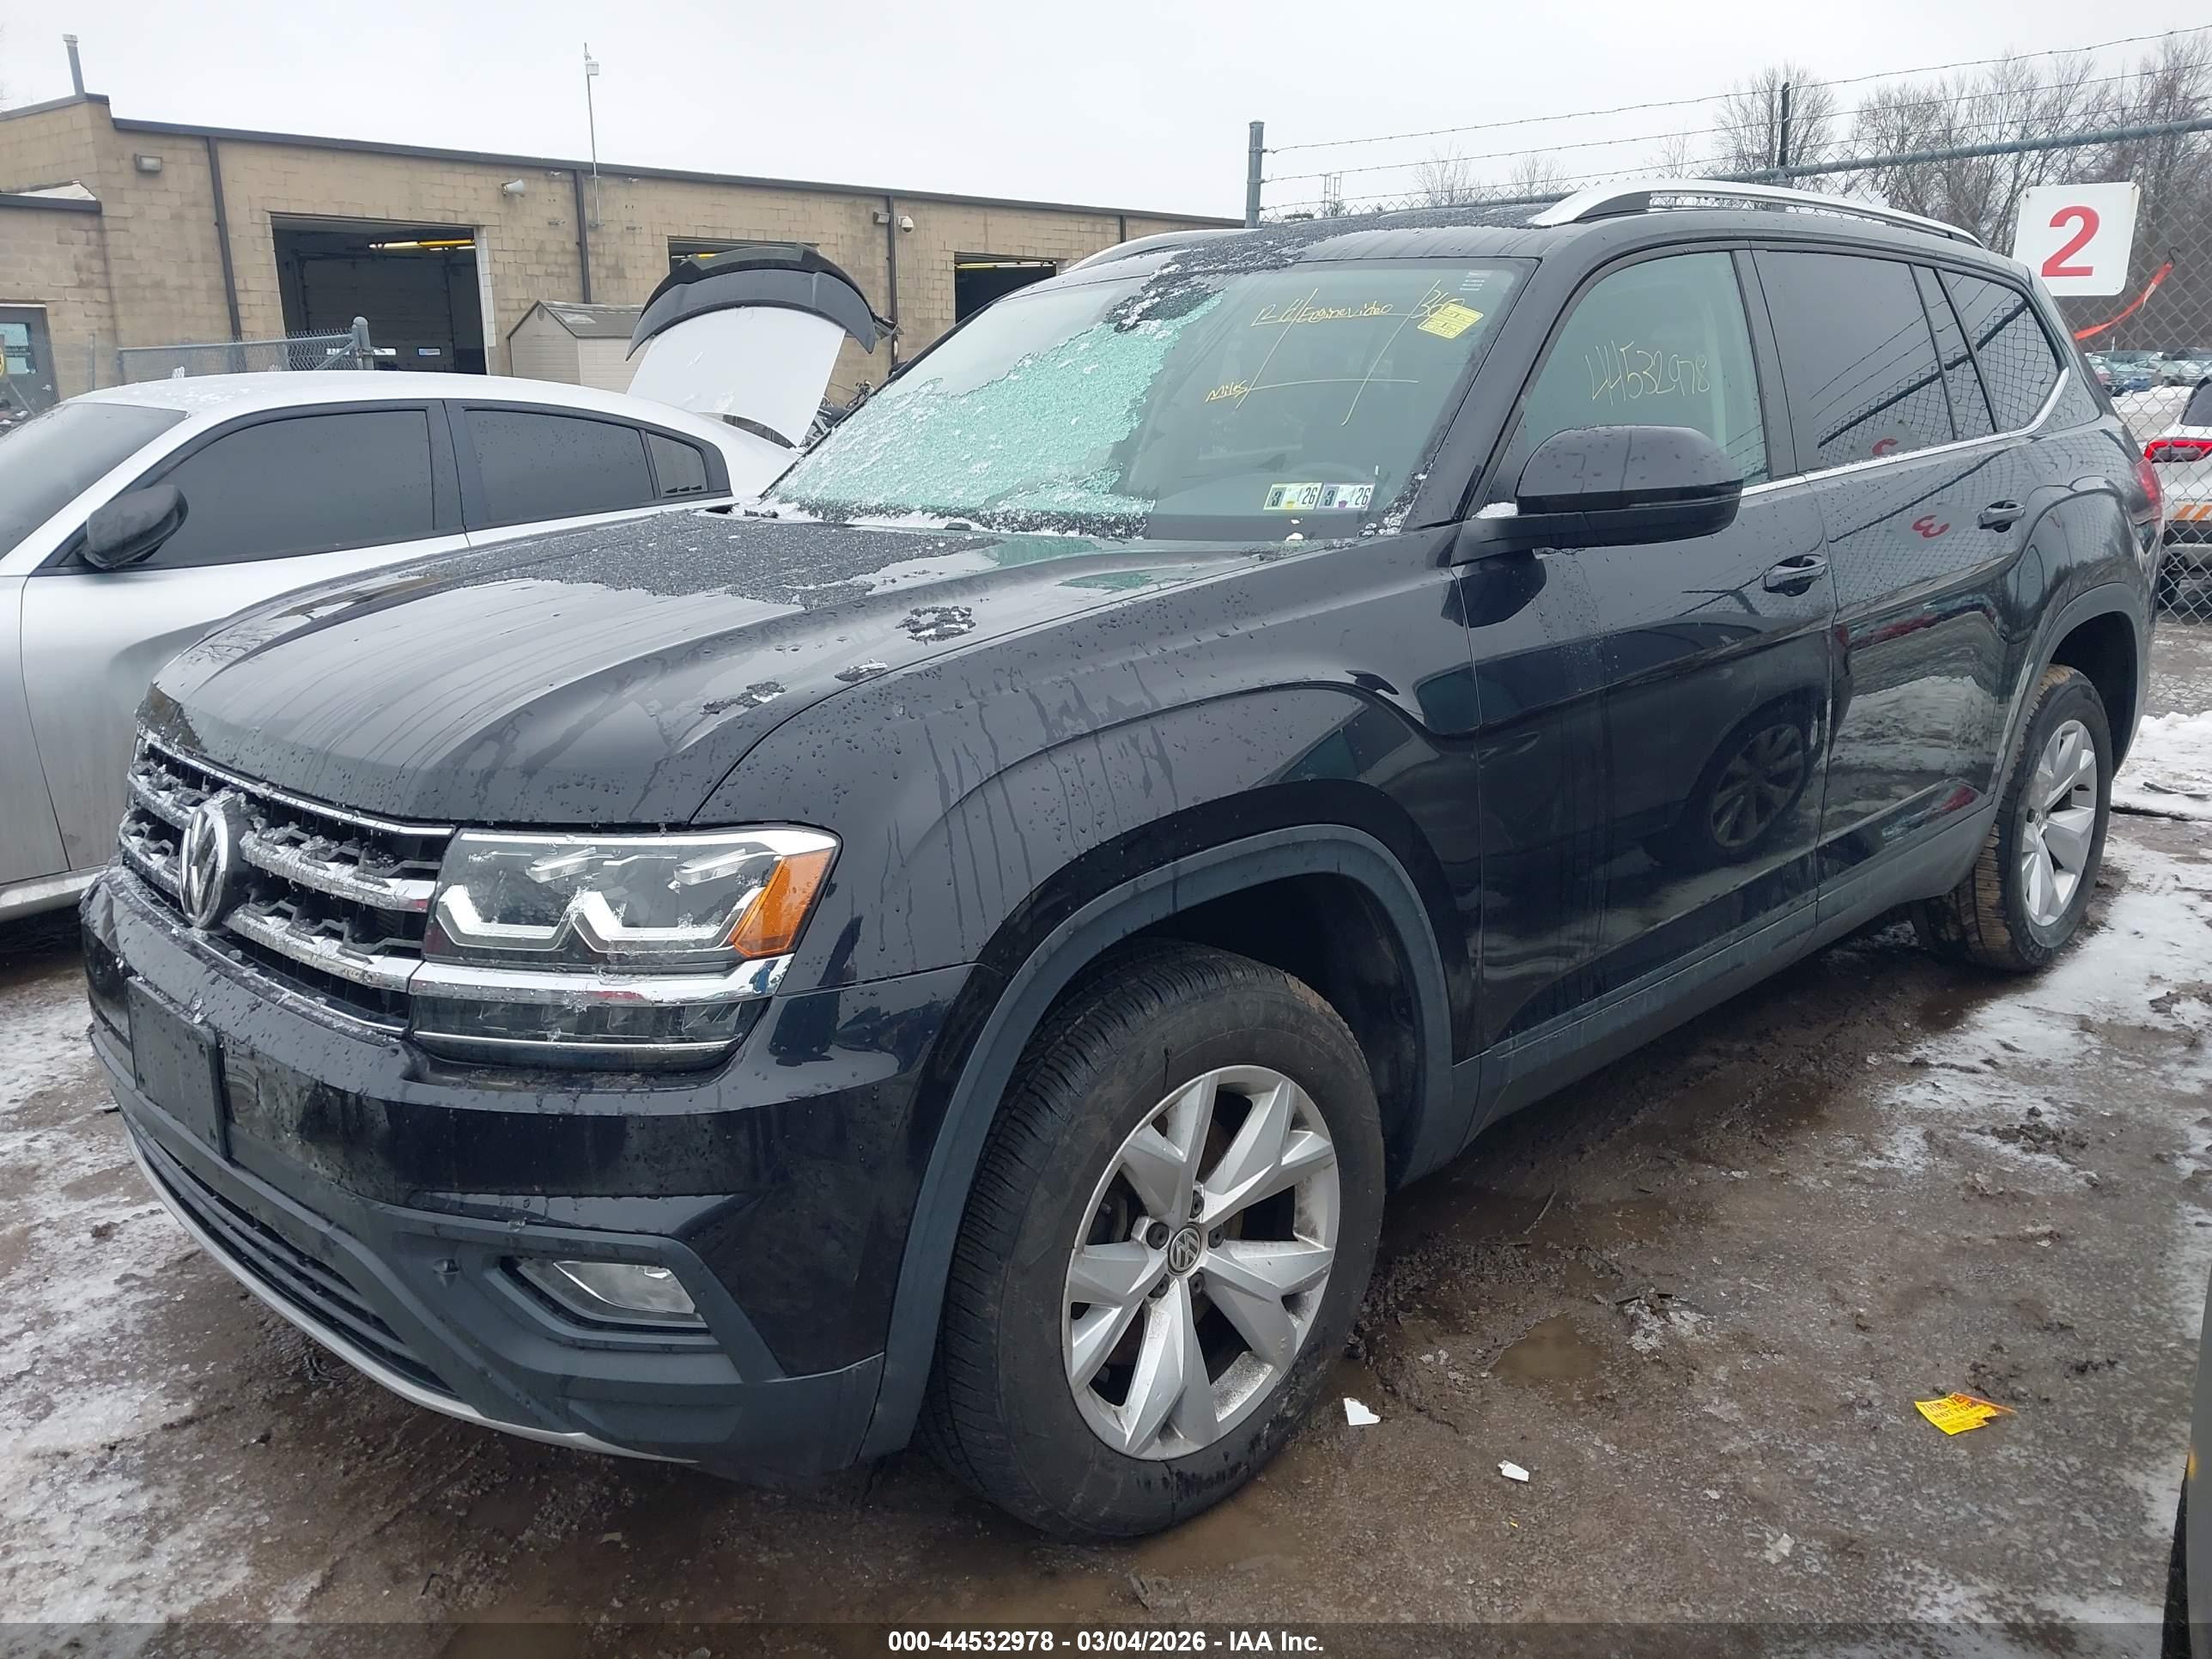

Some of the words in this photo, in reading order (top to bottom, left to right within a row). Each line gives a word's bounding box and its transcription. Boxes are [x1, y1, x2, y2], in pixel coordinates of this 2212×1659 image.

[2041, 205, 2100, 277] 2
[1585, 340, 1711, 406] 44532978
[1271, 491, 1282, 507] 3
[1302, 487, 1318, 505] 26
[1324, 490, 1335, 507] 3
[1355, 487, 1371, 506] 26
[1923, 1401, 1948, 1413] THIS
